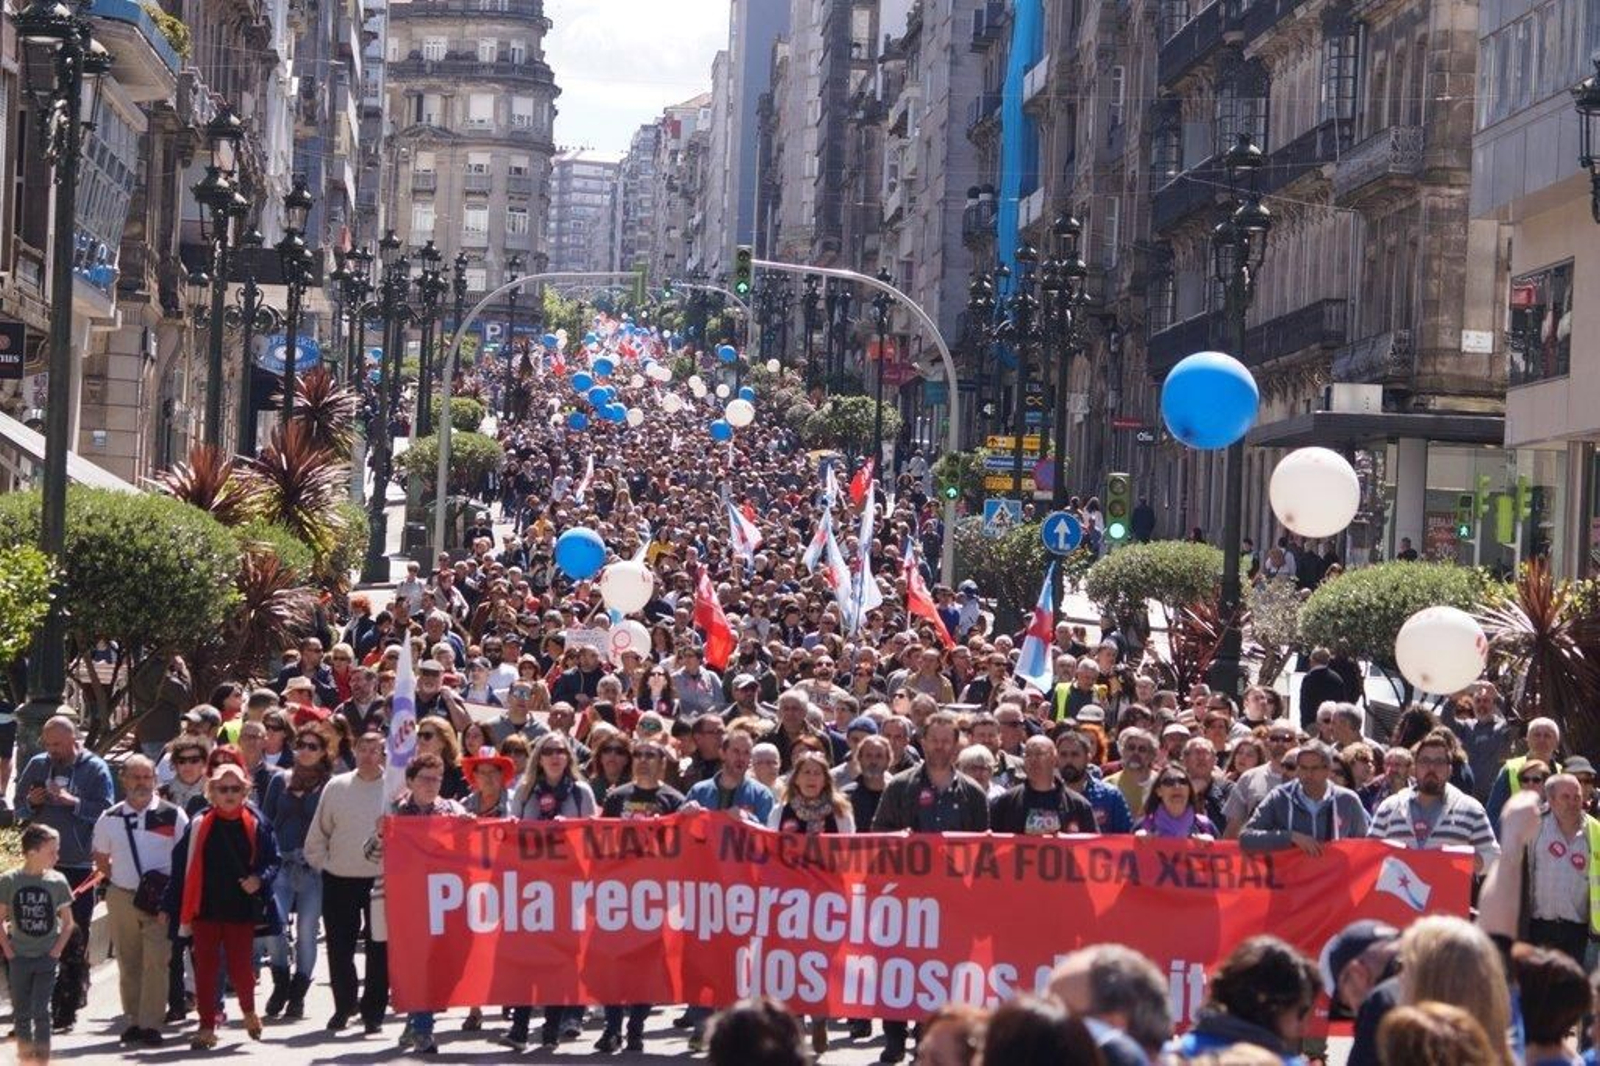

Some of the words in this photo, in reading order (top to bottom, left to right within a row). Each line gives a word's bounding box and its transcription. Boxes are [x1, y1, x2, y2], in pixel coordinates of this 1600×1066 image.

[485, 323, 502, 341] P
[518, 828, 568, 860] DE
[583, 825, 681, 860] MAIO
[719, 825, 769, 865] NO
[946, 842, 1000, 880] DA
[1015, 844, 1140, 886] FOLGA
[1155, 849, 1285, 890] XERAL
[427, 870, 555, 935] Pola
[571, 879, 940, 949] recuperación
[736, 936, 828, 1003] dos
[843, 954, 1017, 1011] nosos
